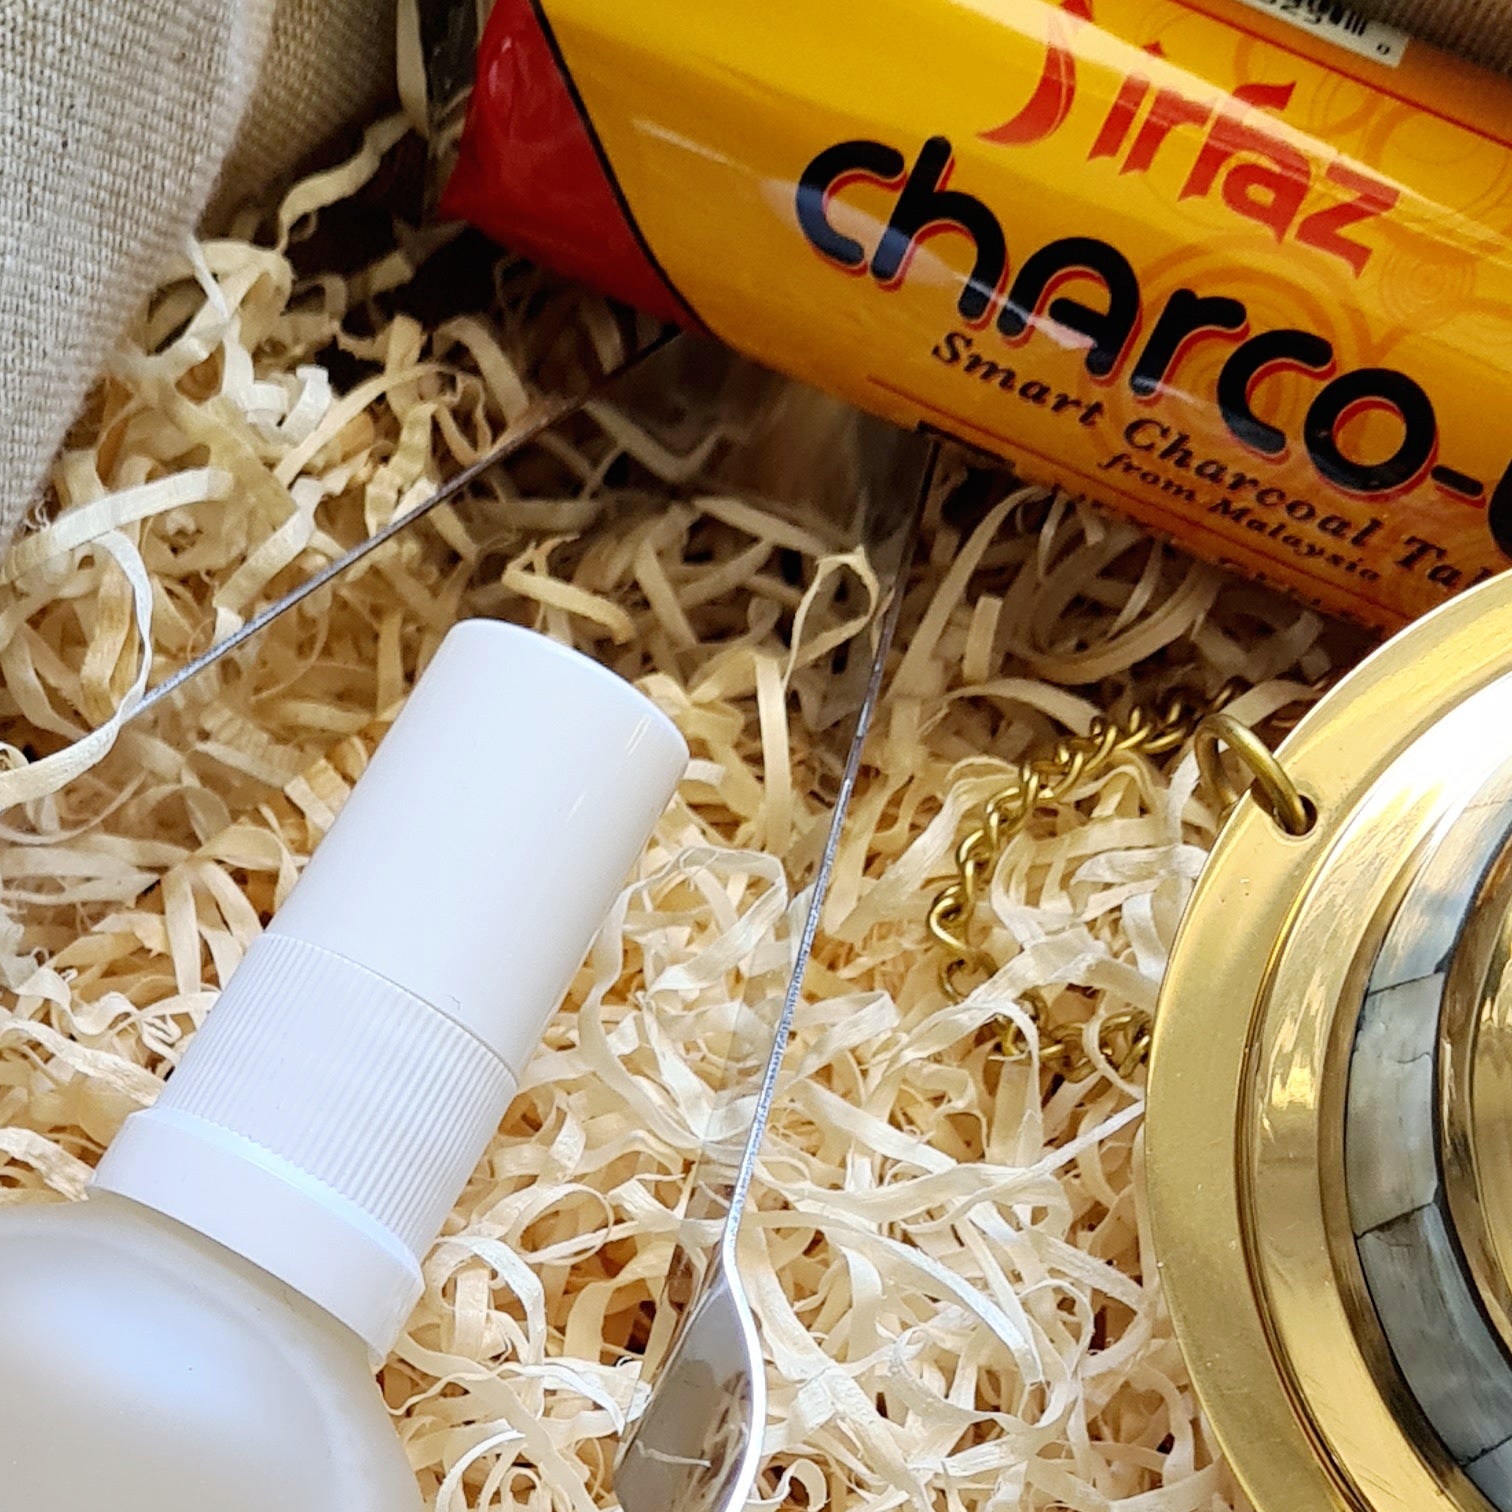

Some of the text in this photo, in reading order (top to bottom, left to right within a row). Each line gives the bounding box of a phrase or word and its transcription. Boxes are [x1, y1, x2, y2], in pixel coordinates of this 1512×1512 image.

[932, 330, 1105, 428] Smart
[1124, 417, 1383, 549] Charcoal
[1098, 452, 1382, 584] from Malaysia
